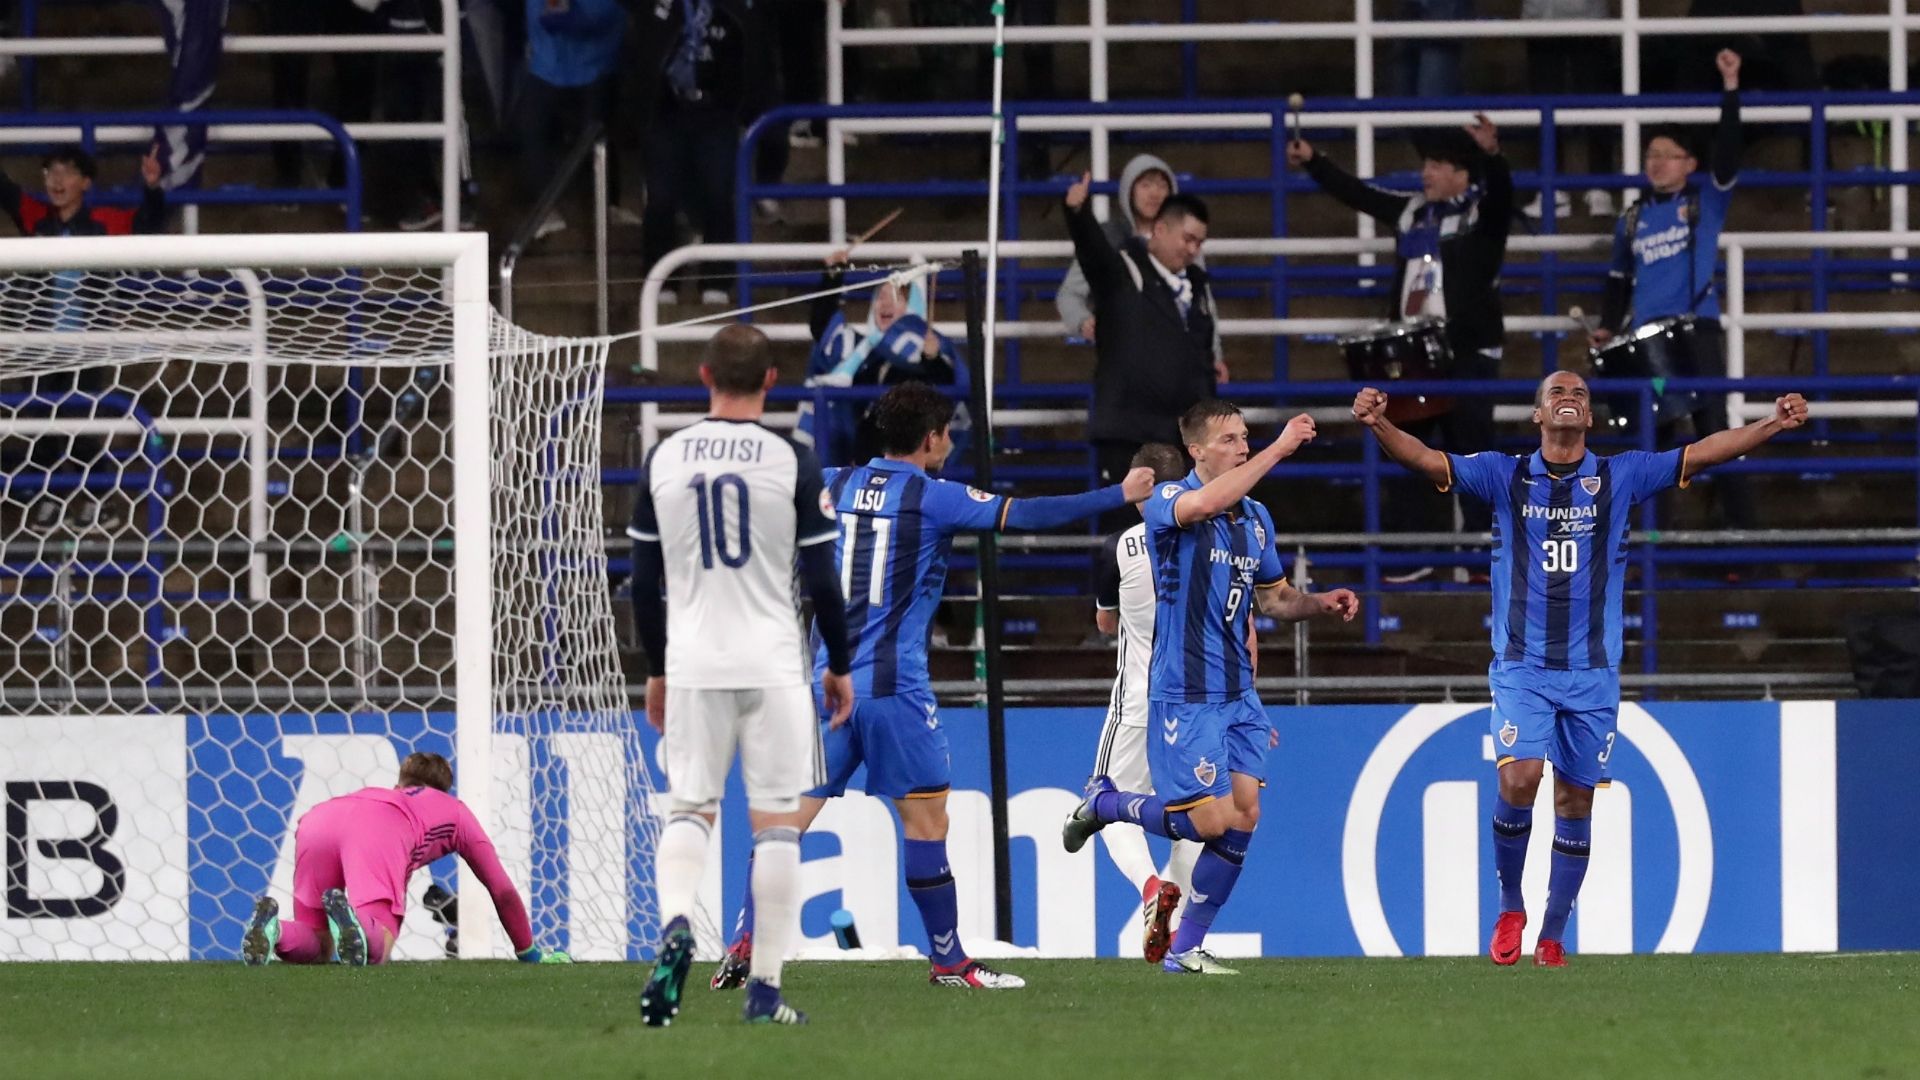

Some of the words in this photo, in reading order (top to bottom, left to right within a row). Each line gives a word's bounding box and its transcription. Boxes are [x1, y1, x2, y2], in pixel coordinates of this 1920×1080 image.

[682, 437, 763, 463] TROISI
[853, 488, 886, 512] ILSU
[1522, 504, 1598, 520] HYUNDAI
[687, 472, 751, 569] 10
[840, 512, 891, 607] 11
[1542, 540, 1578, 573] 30
[1225, 588, 1242, 622] 9
[1597, 731, 1616, 763] 3
[6, 781, 126, 919] B
[1555, 835, 1588, 847] UHFC
